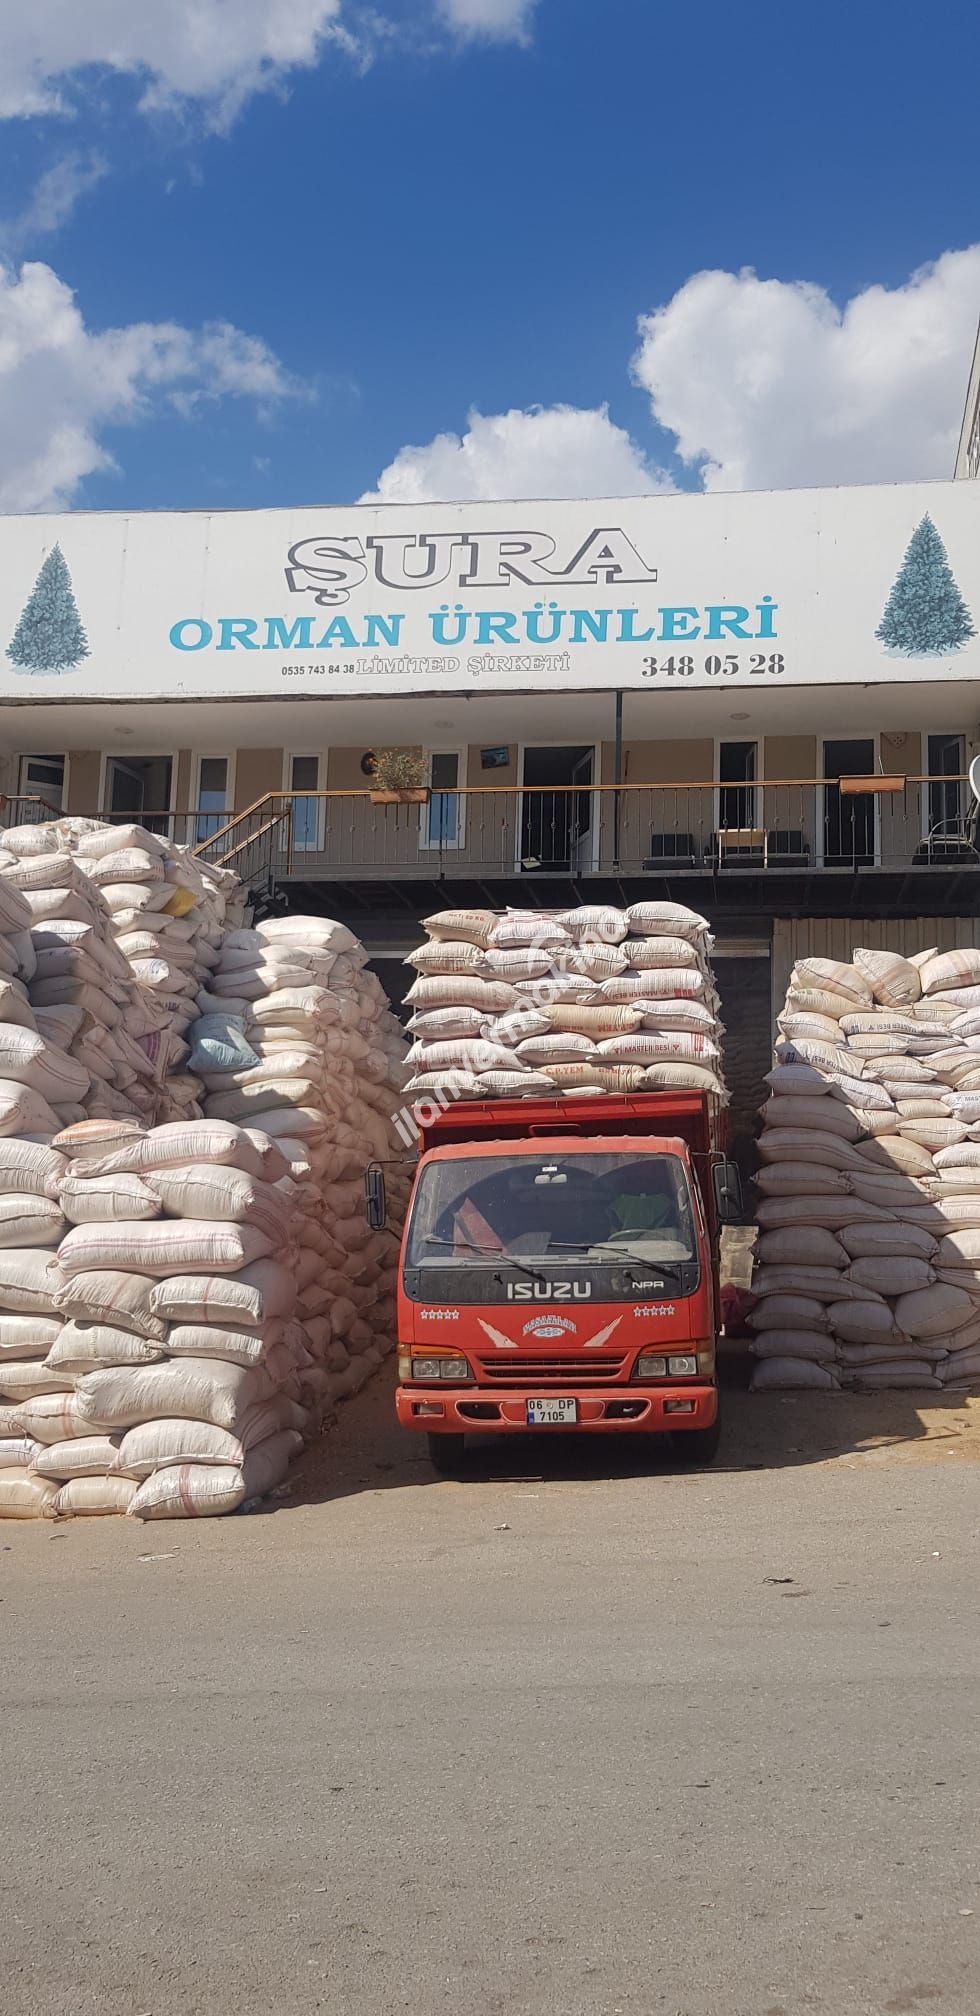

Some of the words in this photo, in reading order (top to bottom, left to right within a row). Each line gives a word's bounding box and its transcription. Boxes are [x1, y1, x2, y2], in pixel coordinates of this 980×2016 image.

[284, 527, 658, 606] ŞURA
[169, 614, 405, 651] ORMAN
[428, 595, 779, 645] ÜRÜNLERİ
[281, 666, 305, 676] 0535
[308, 665, 326, 675] 743
[328, 665, 341, 675] 84
[343, 664, 355, 674] 38
[356, 654, 460, 674] LİMİTED
[467, 651, 571, 676] ŞİRKETİ
[642, 655, 694, 677] 348
[704, 654, 739, 676] 05
[749, 653, 785, 675] 28
[507, 1281, 592, 1299] ISUZU
[529, 1400, 543, 1410] 06
[558, 1399, 574, 1410] DP
[539, 1411, 565, 1421] 7105
